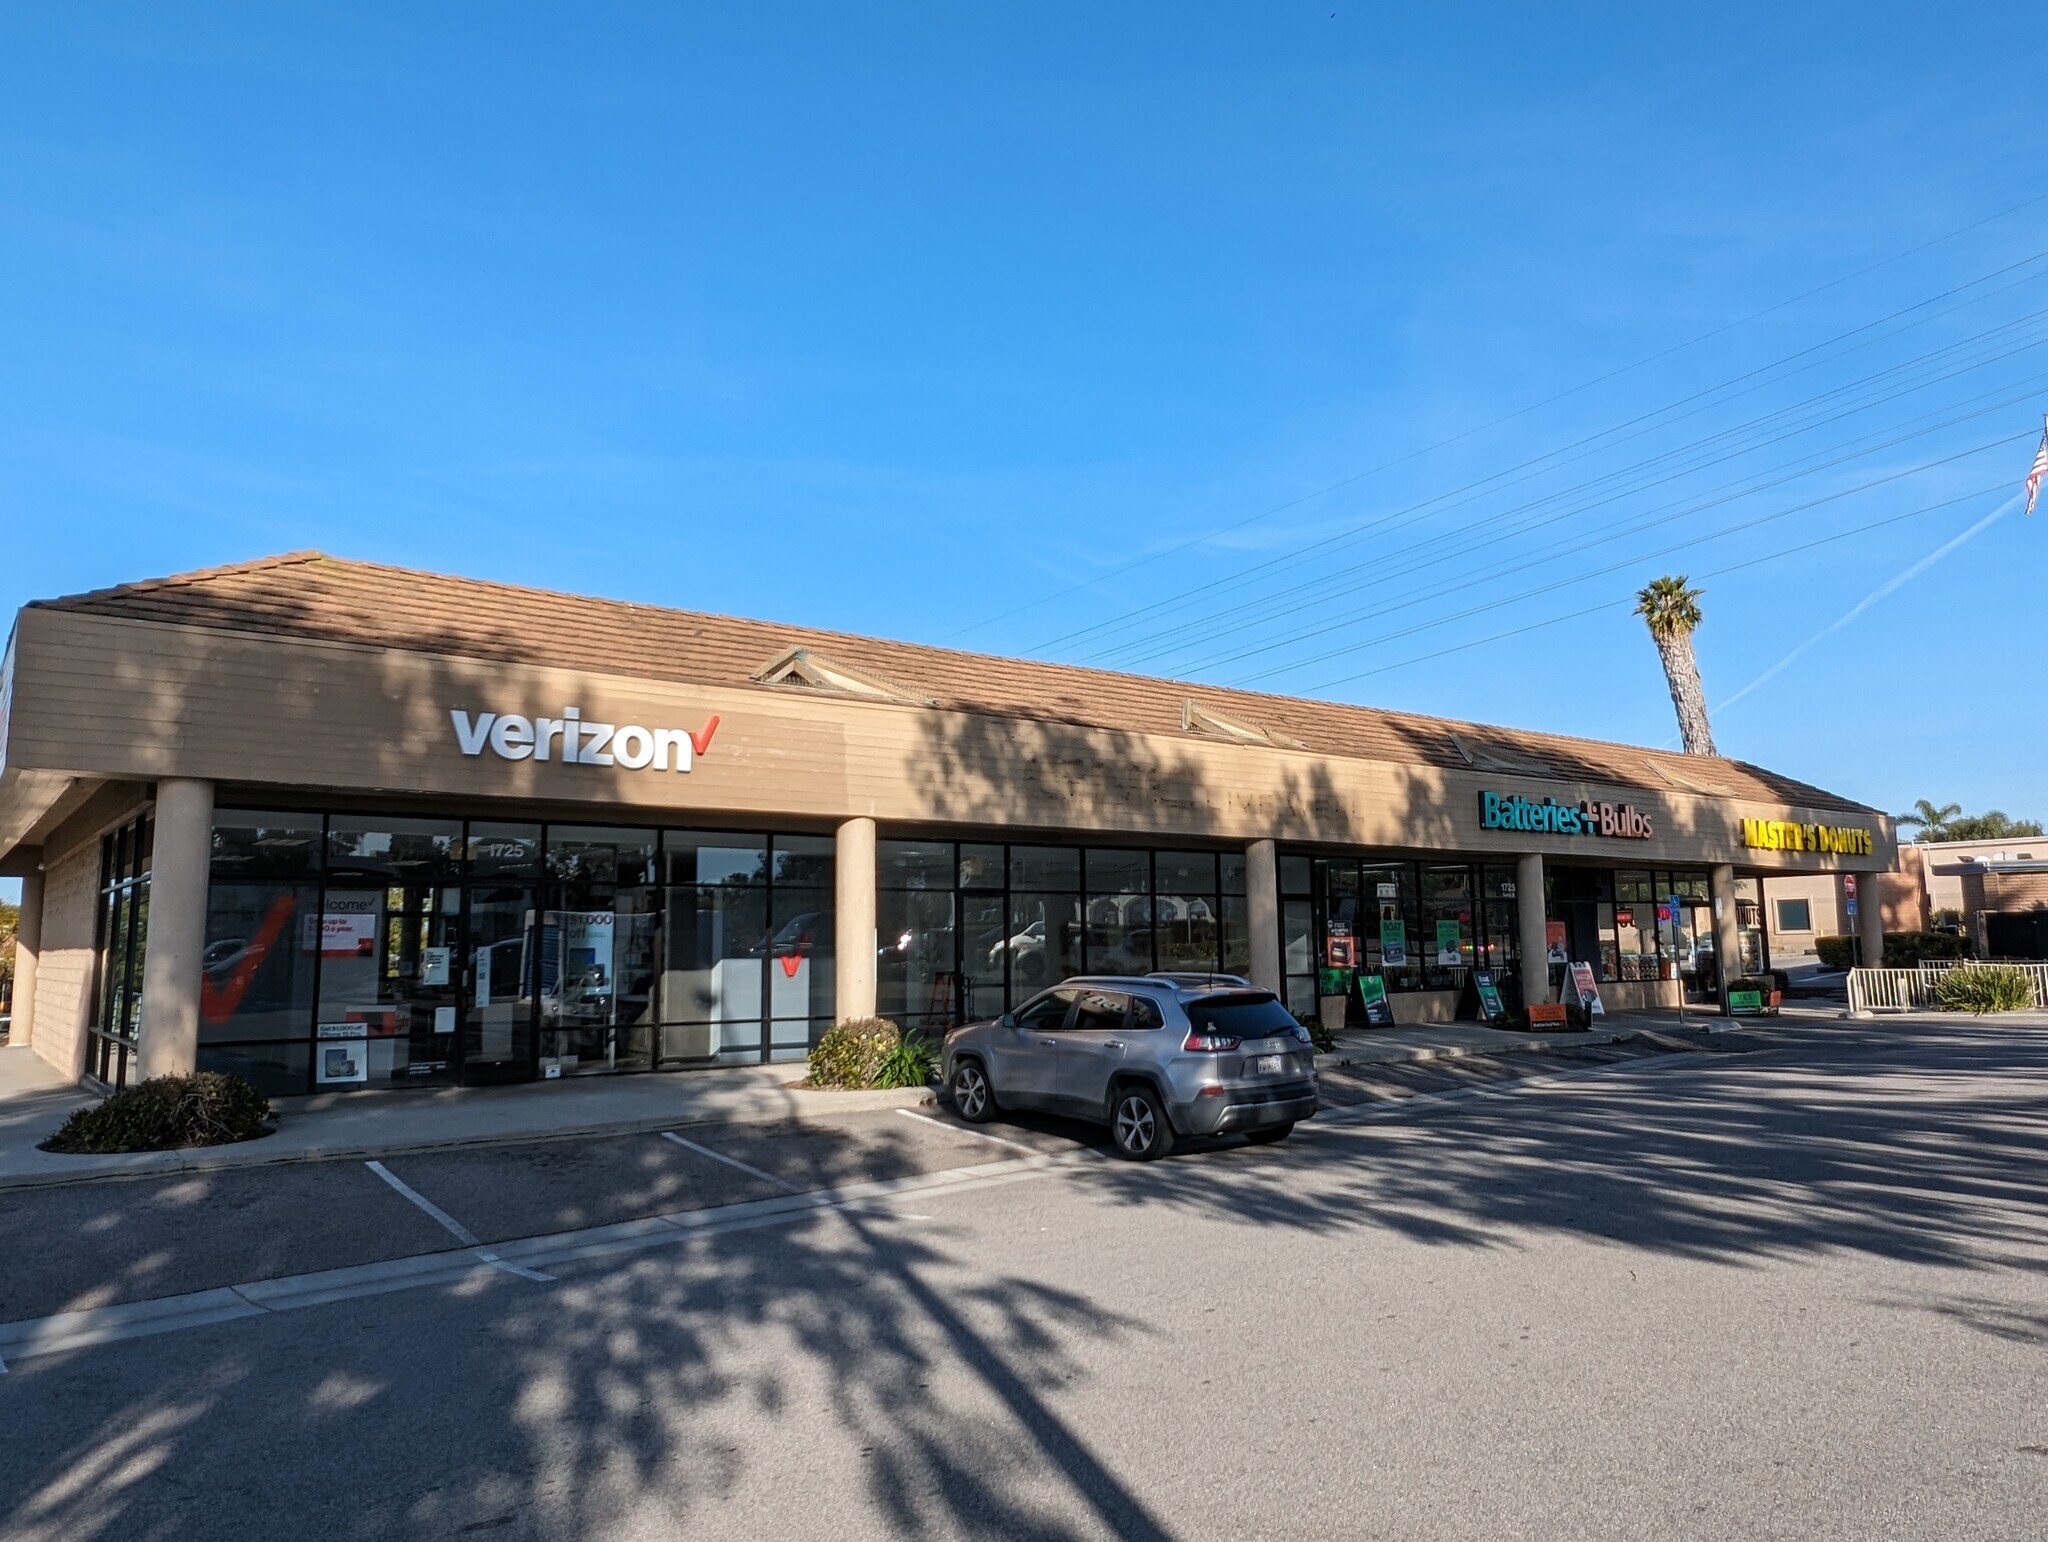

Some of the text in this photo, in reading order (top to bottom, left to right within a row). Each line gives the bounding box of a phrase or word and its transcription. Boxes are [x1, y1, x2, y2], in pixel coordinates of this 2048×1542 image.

[451, 706, 693, 772] verizon
[1483, 791, 1582, 834] Batteries
[1600, 802, 1654, 839] Bulbs
[1743, 817, 1873, 856] MASTER'S DONUTS
[489, 843, 525, 858] 1725
[1500, 882, 1516, 892] 1725
[1736, 907, 1761, 925] ONUTS
[1383, 922, 1402, 931] BOAT
[1737, 993, 1753, 1001] YES
